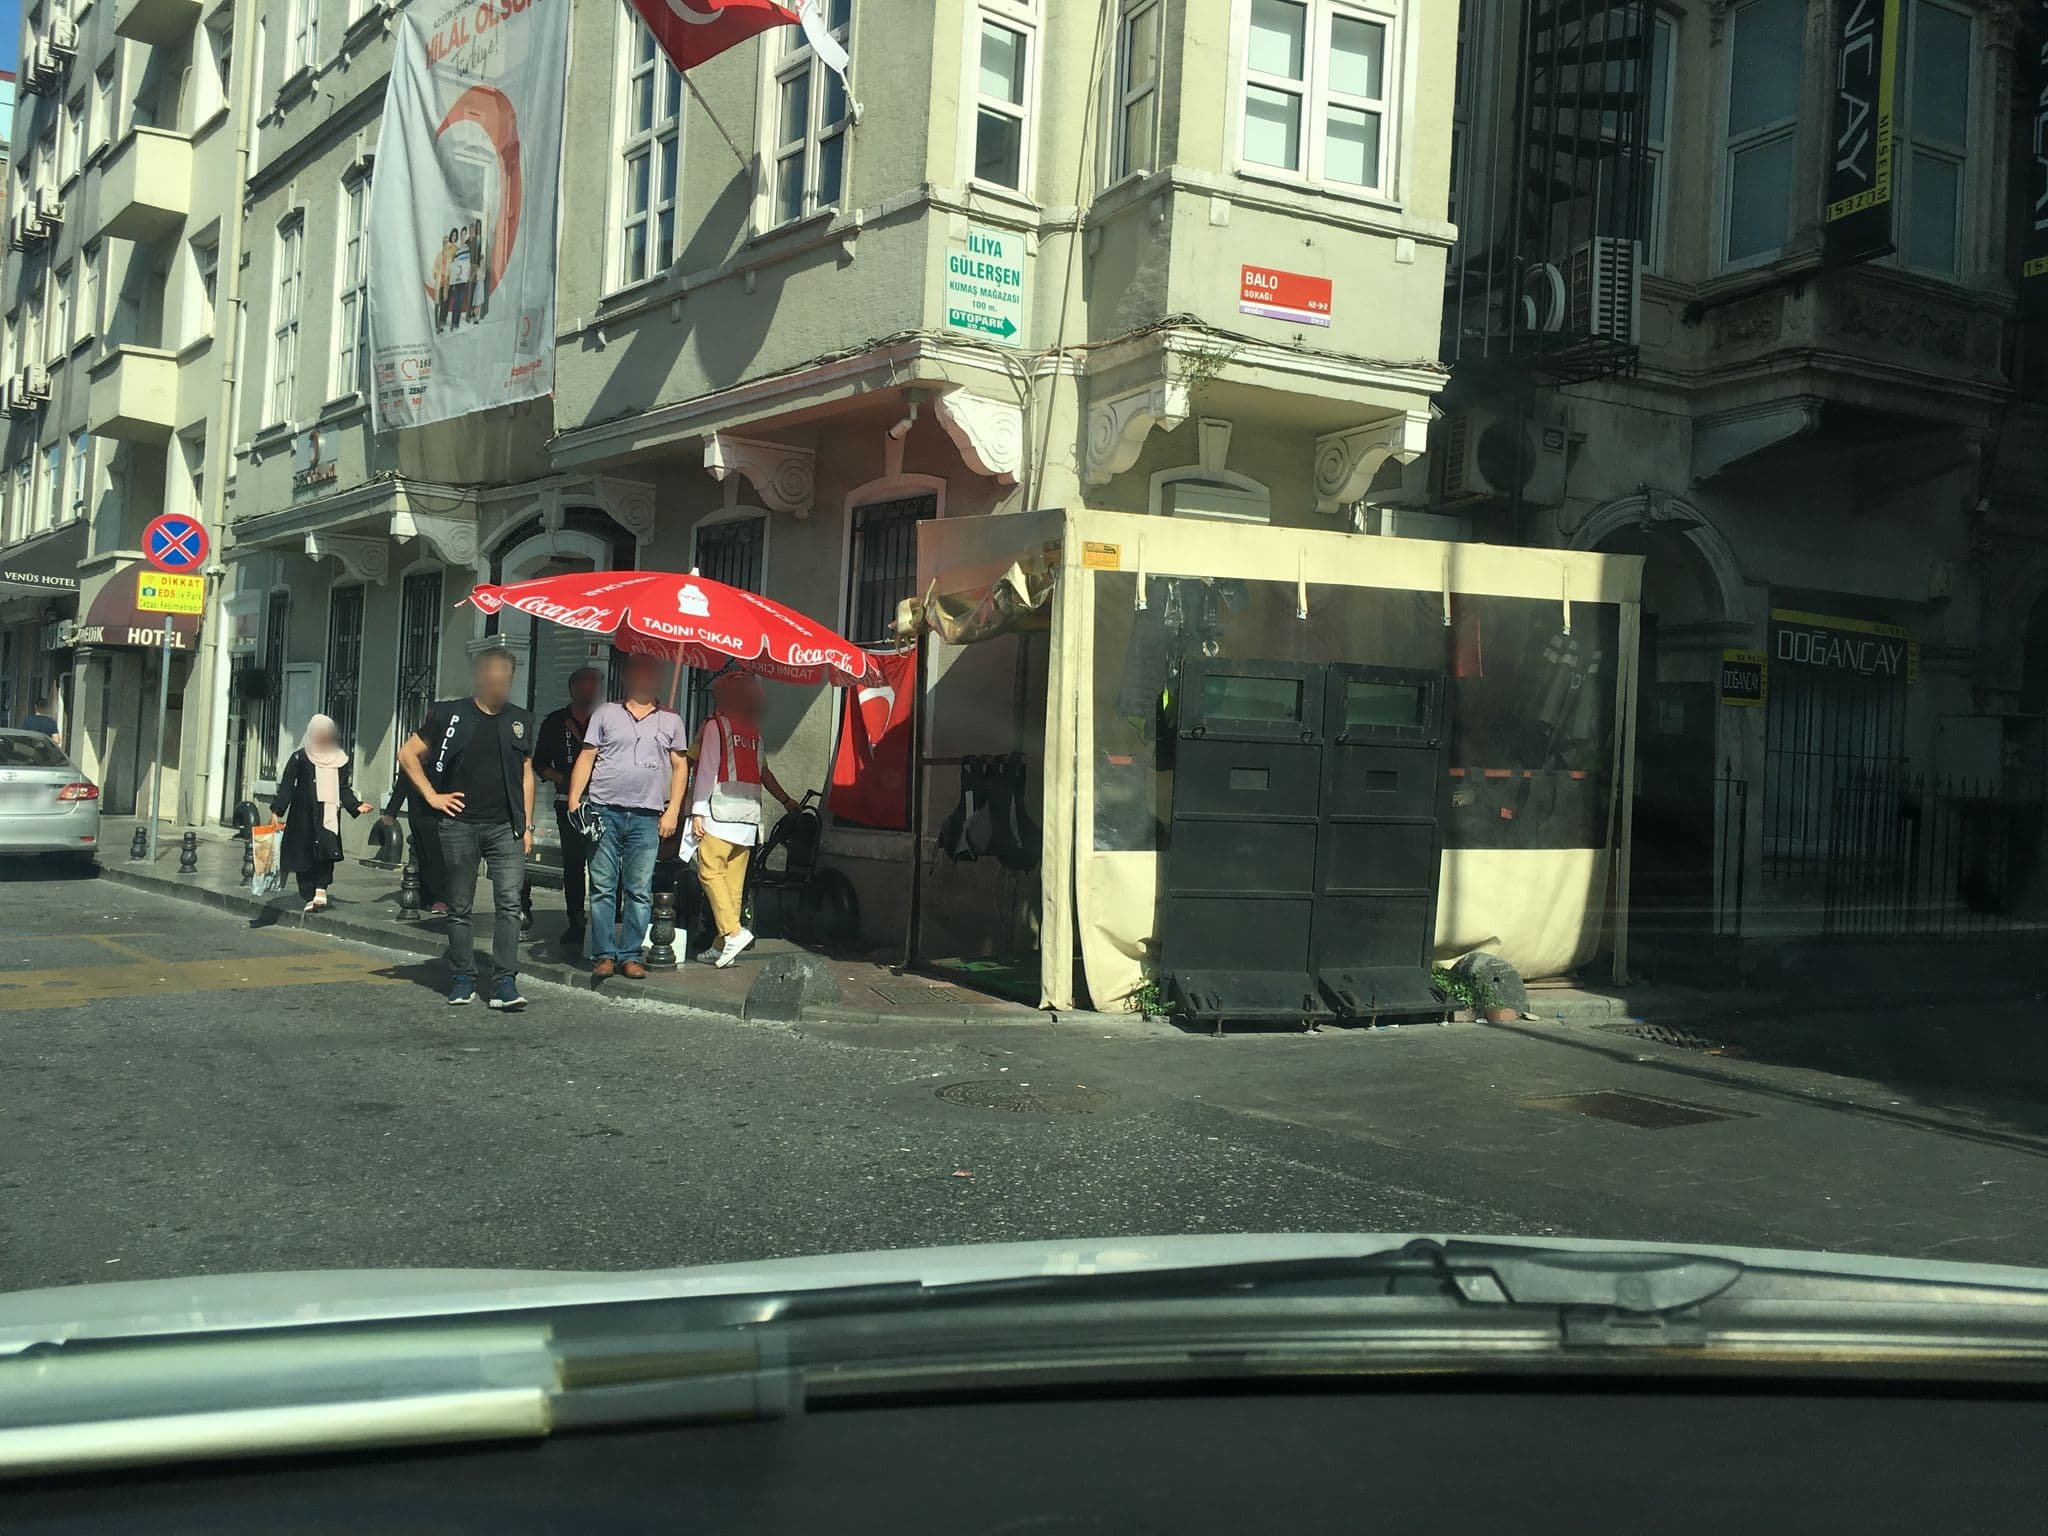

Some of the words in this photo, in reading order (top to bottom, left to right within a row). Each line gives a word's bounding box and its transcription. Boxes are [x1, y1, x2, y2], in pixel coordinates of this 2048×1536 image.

[475, 0, 532, 34] OLSU
[968, 231, 1002, 258] İLİYA
[950, 254, 1020, 288] GÜLERŞEN
[1245, 271, 1278, 290] BALO
[949, 281, 978, 297] KUMAŞ
[980, 286, 1020, 304] MAĞAZASI
[972, 300, 986, 309] 100
[951, 310, 1005, 329] OTOPARK
[4, 571, 39, 583] VENÜS
[41, 576, 76, 587] HOTEL
[157, 588, 176, 598] EDS
[642, 616, 694, 637] TADINI
[1777, 629, 1904, 676] DOĞANÇAY
[565, 727, 574, 763] OLIS
